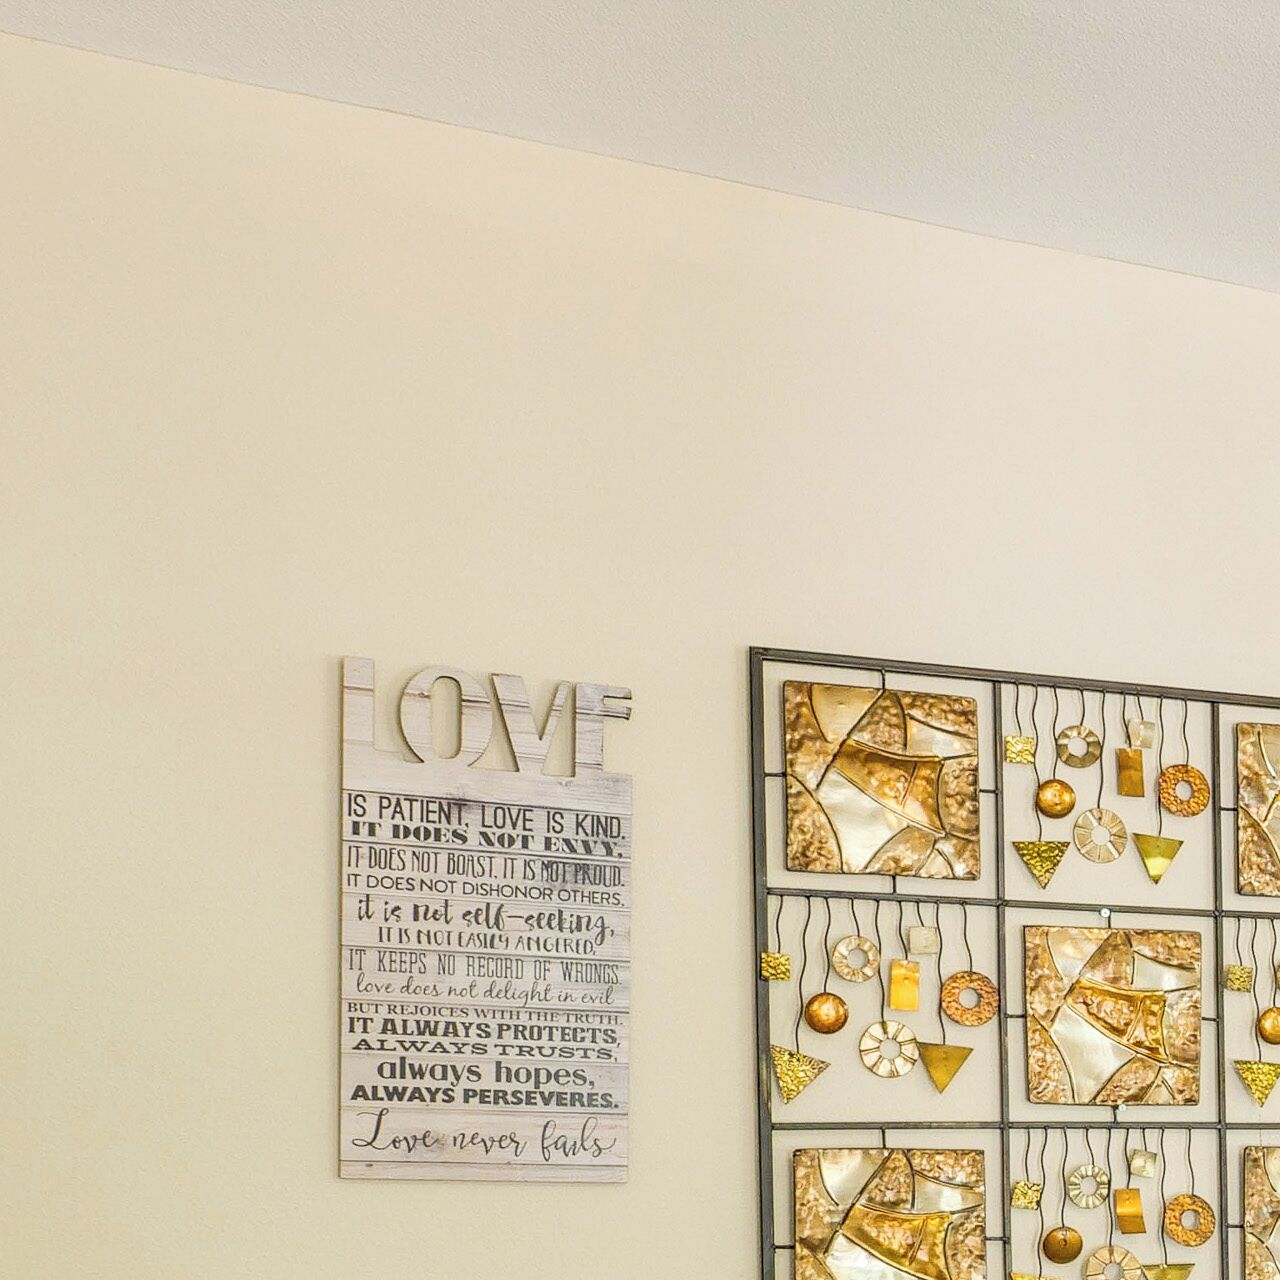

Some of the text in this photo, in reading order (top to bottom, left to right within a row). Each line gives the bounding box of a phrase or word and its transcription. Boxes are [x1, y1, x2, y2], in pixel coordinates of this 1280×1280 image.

[341, 656, 632, 778] LOVE
[348, 793, 625, 840] IS PATIENT, LOVE IS KIND.
[352, 820, 623, 859] IT DOES NOT ENVY,
[348, 846, 362, 868] IT
[368, 846, 406, 871] DOES
[412, 850, 441, 874] NOT
[504, 857, 518, 879] IT
[523, 859, 535, 881] IS
[541, 860, 569, 883] NOT
[572, 862, 625, 887] PROUD.
[348, 873, 361, 887] IT
[367, 875, 416, 892] DOES
[420, 878, 457, 894] NOT
[463, 881, 553, 901] DISHONOR
[358, 894, 375, 921] it
[384, 900, 402, 923] is
[413, 899, 453, 925] not
[378, 926, 393, 942] IT
[399, 927, 411, 944] IS
[417, 929, 453, 946] NOT
[458, 931, 509, 949] EASILY
[349, 948, 622, 985] IT KEEPS NO RECORD OF WRONGS.
[356, 972, 615, 1008] love does not delight in evil
[347, 1002, 623, 1025] BUT REJOICES WITH THE TRUTH.
[348, 1016, 621, 1048] IT ALWAYS PROTECTS,
[352, 1038, 618, 1062] ALWAYS TRUSTS,
[377, 1056, 595, 1090] always hopes,
[350, 1085, 619, 1108] ALWAYS PERSEVERES.
[351, 1108, 440, 1154] Love
[452, 1128, 528, 1157] never
